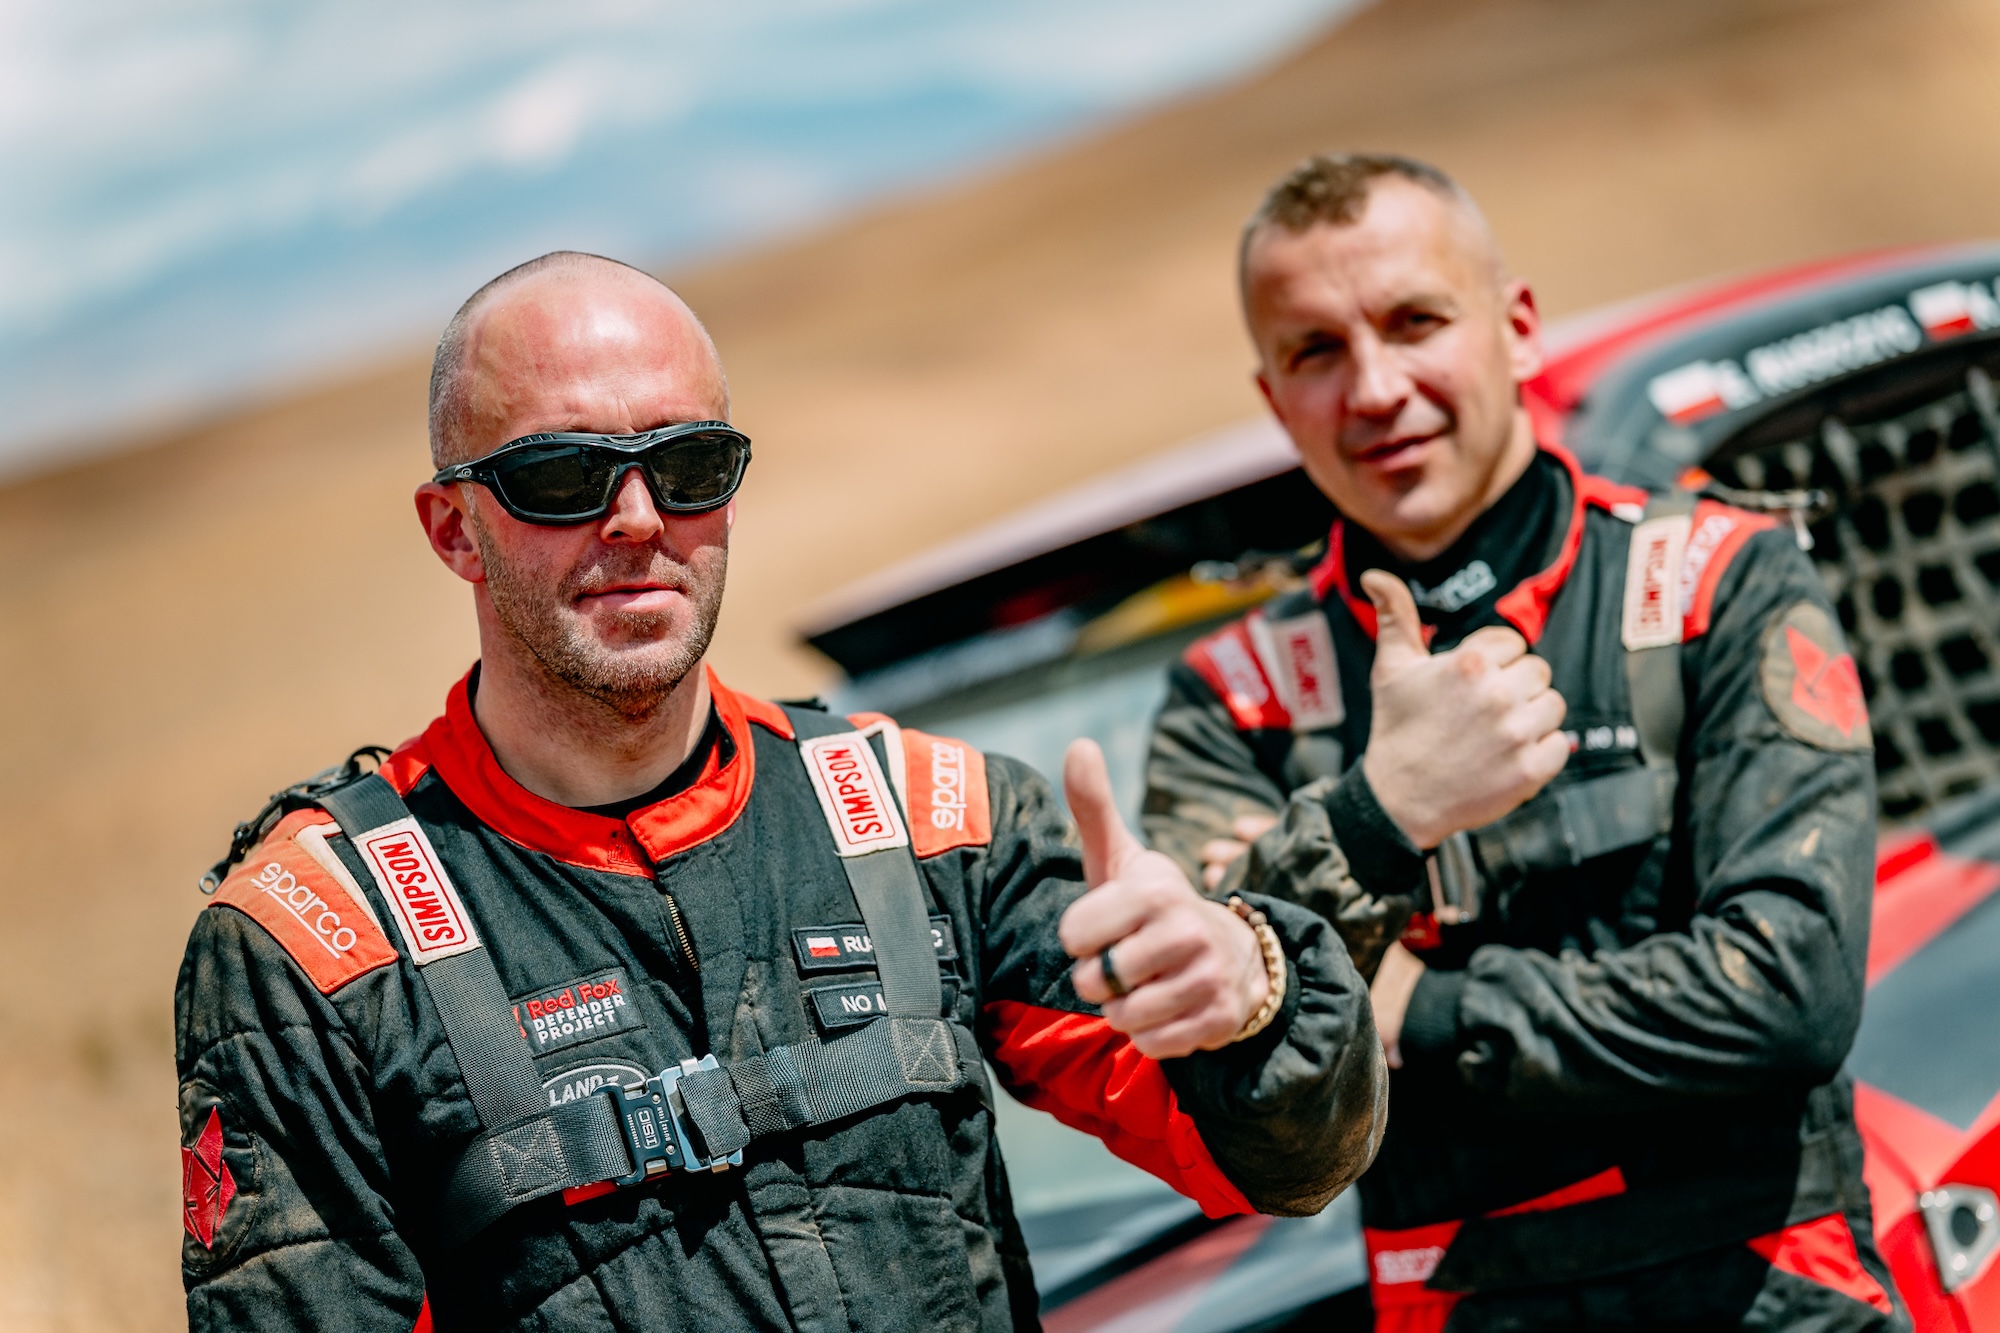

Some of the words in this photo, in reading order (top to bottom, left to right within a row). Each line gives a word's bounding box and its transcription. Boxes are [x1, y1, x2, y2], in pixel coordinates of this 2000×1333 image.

[822, 748, 884, 836] SIMPSON
[255, 862, 357, 955] sparco
[378, 841, 456, 942] SIMPSON
[526, 989, 576, 1020] Red
[577, 979, 622, 1004] Fox
[532, 994, 626, 1032] DEFENDER
[840, 994, 872, 1013] NO
[537, 1010, 615, 1044] PROJECT
[548, 1075, 604, 1107] LAND
